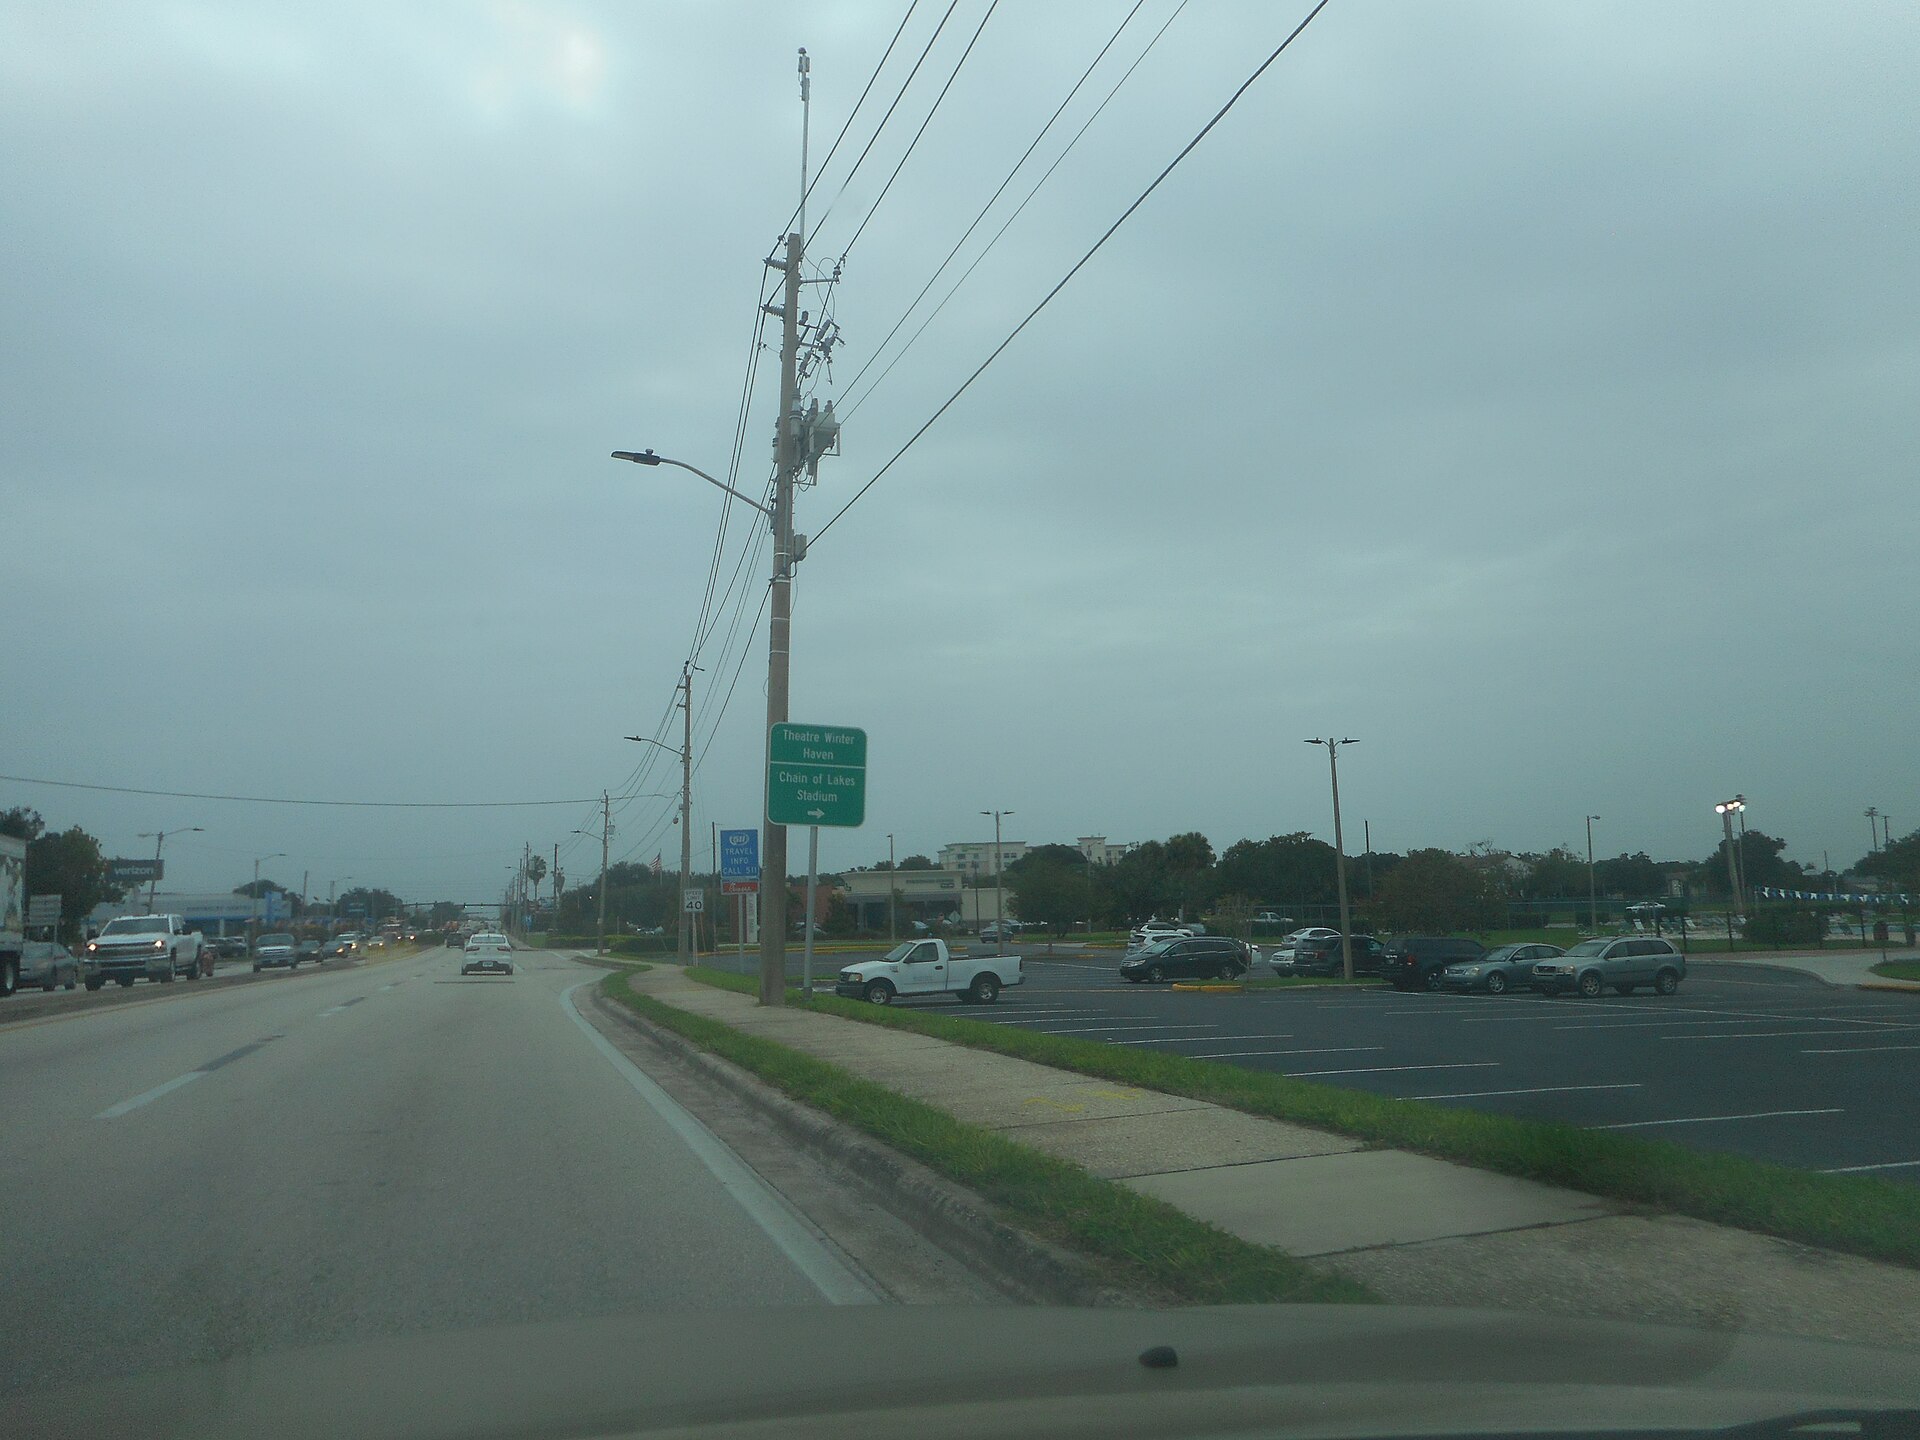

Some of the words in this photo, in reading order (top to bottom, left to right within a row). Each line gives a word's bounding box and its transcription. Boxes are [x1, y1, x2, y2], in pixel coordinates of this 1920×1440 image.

[783, 729, 820, 742] Theatre
[825, 732, 855, 745] Winter
[803, 748, 834, 760] Haven
[779, 771, 808, 784] Chain
[812, 774, 822, 784] of
[827, 774, 855, 786] Lakes
[797, 789, 838, 802] Stadium
[724, 847, 753, 855] TRAVEL
[730, 857, 749, 865] INFO
[113, 865, 155, 875] verizon
[722, 867, 741, 875] CALL
[686, 901, 702, 910] 40
